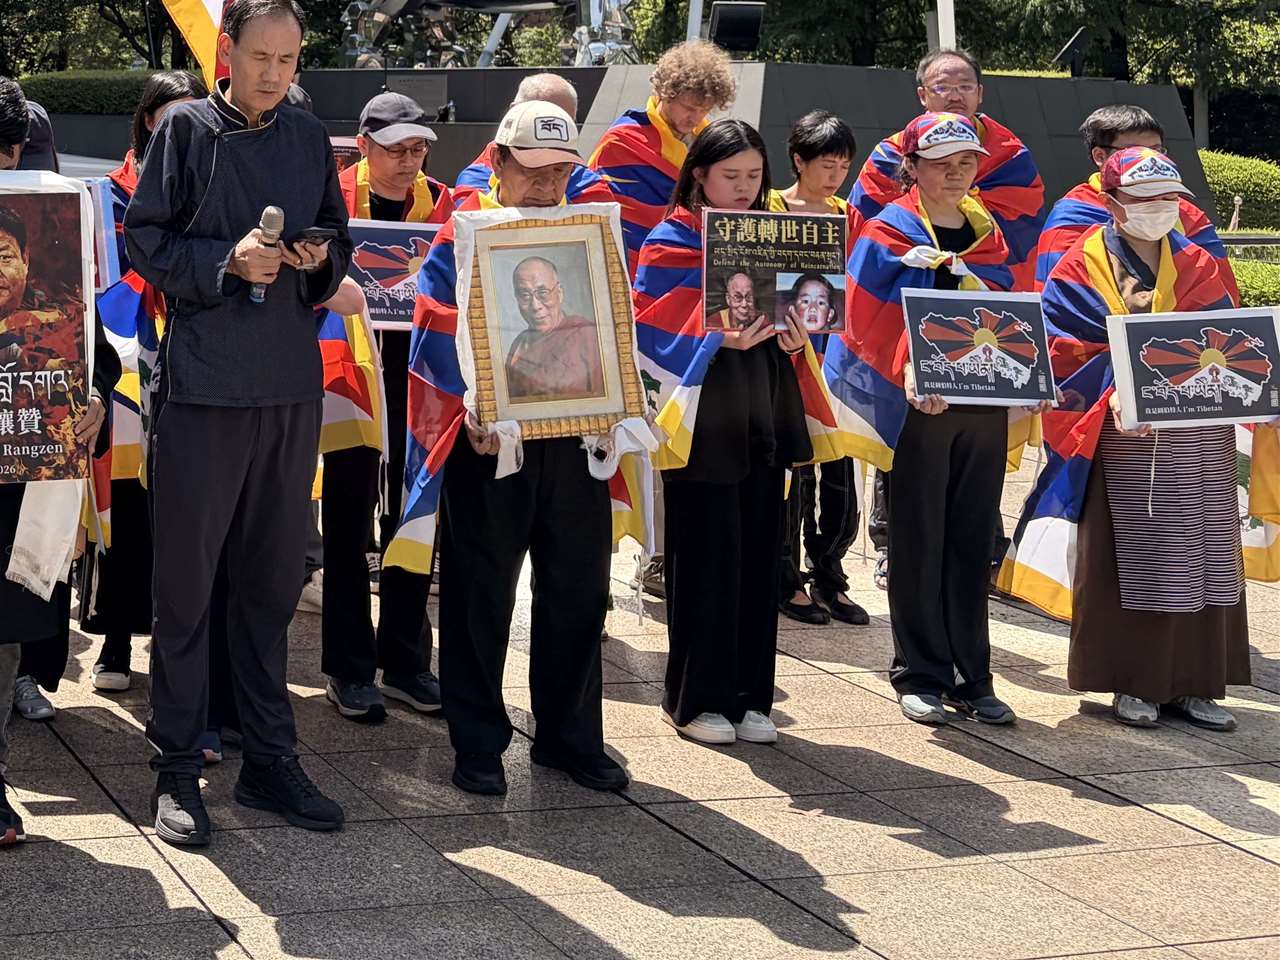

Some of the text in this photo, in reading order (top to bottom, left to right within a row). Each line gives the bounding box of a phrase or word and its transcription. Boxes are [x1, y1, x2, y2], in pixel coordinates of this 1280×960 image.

[715, 217, 840, 245] 守護轉世自主
[970, 383, 996, 391] Tibetan
[1196, 405, 1223, 413] Tibetan
[3, 443, 64, 458] Rangzen
